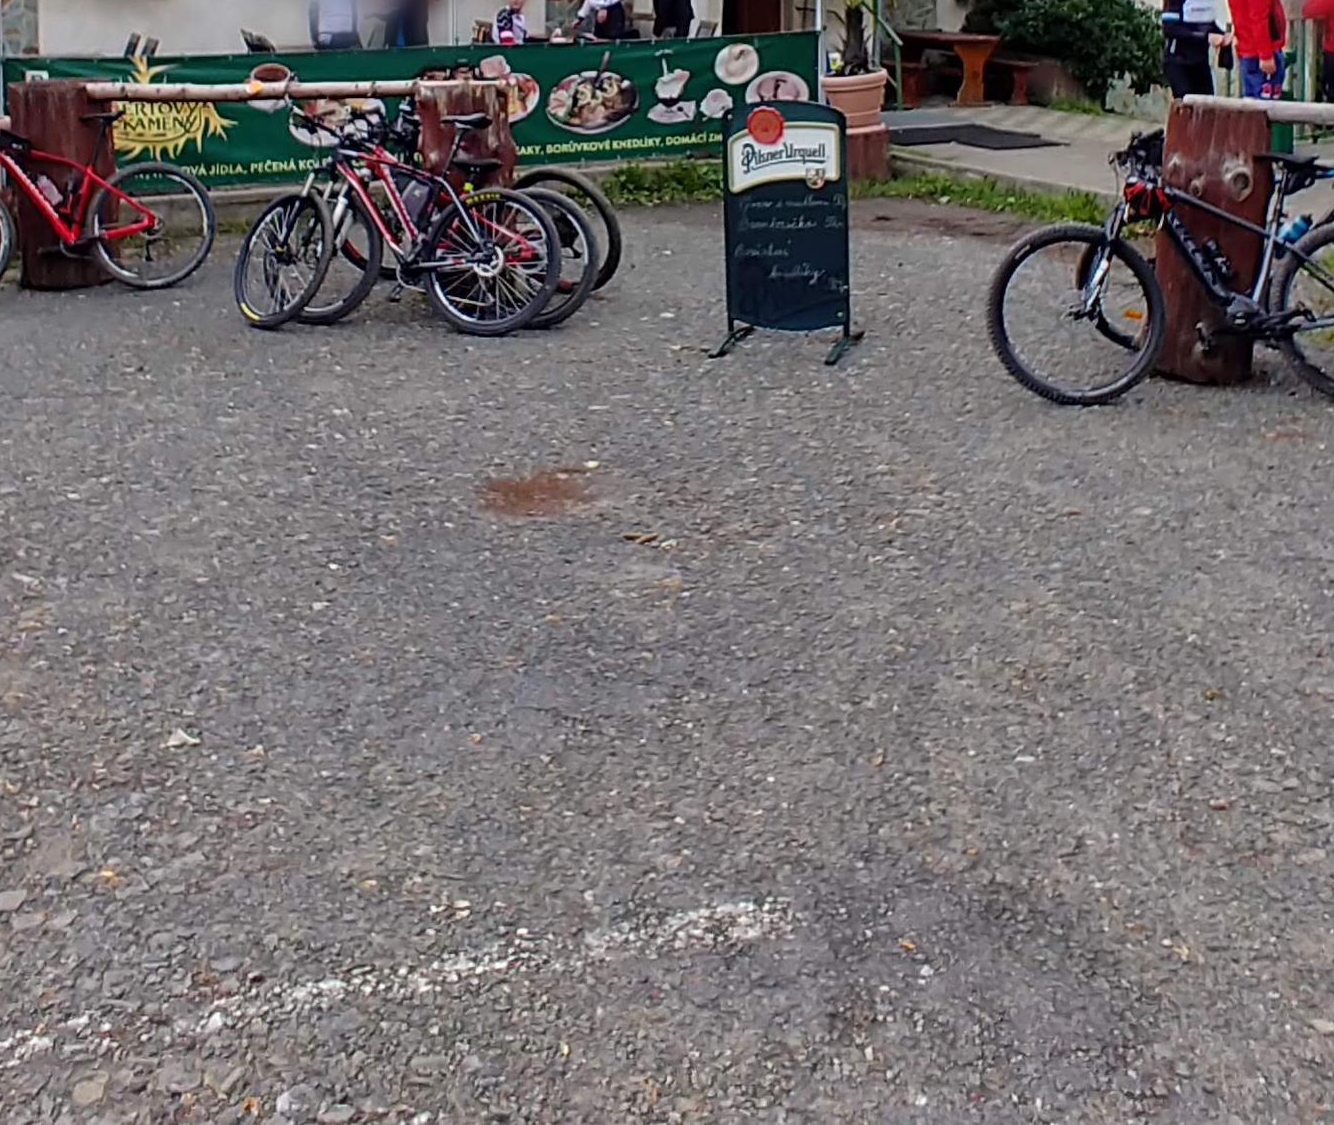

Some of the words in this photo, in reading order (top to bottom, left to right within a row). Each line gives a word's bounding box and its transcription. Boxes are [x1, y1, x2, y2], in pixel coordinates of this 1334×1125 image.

[123, 102, 199, 117] ERTOVY
[123, 116, 198, 134] KAMENY
[250, 158, 296, 174] PEČENÁ
[546, 139, 611, 154] BORŮVKOVÉ
[612, 136, 664, 150] KNEDLÍKY,
[666, 131, 707, 146] DOMÁCÍ
[741, 142, 785, 175] Pilsner
[783, 141, 826, 165] Urquell
